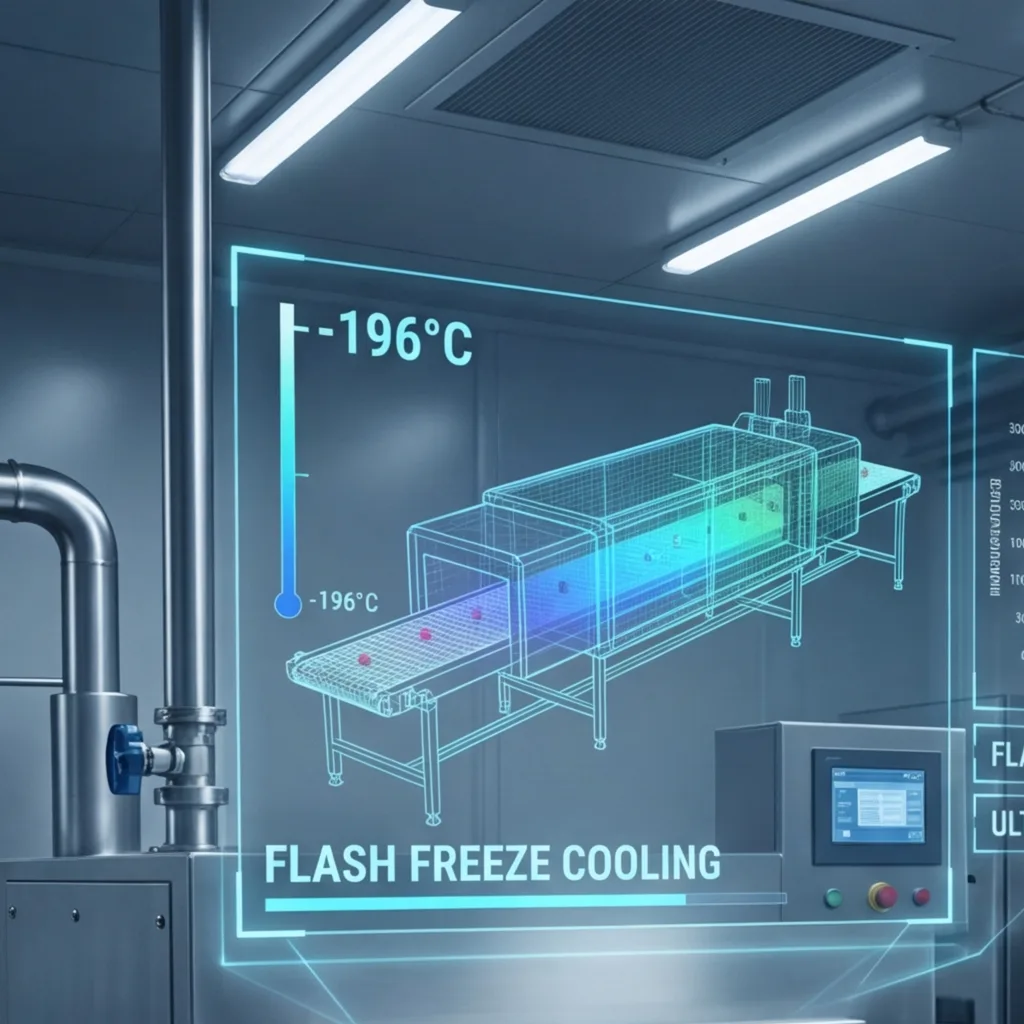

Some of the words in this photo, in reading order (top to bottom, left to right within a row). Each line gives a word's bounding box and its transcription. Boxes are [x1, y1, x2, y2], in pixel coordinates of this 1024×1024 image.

[318, 310, 473, 366] -196°C
[309, 590, 379, 613] -196°C
[265, 844, 396, 883] FLASH
[411, 844, 550, 882] FREEZE
[562, 844, 721, 881] COOLING
